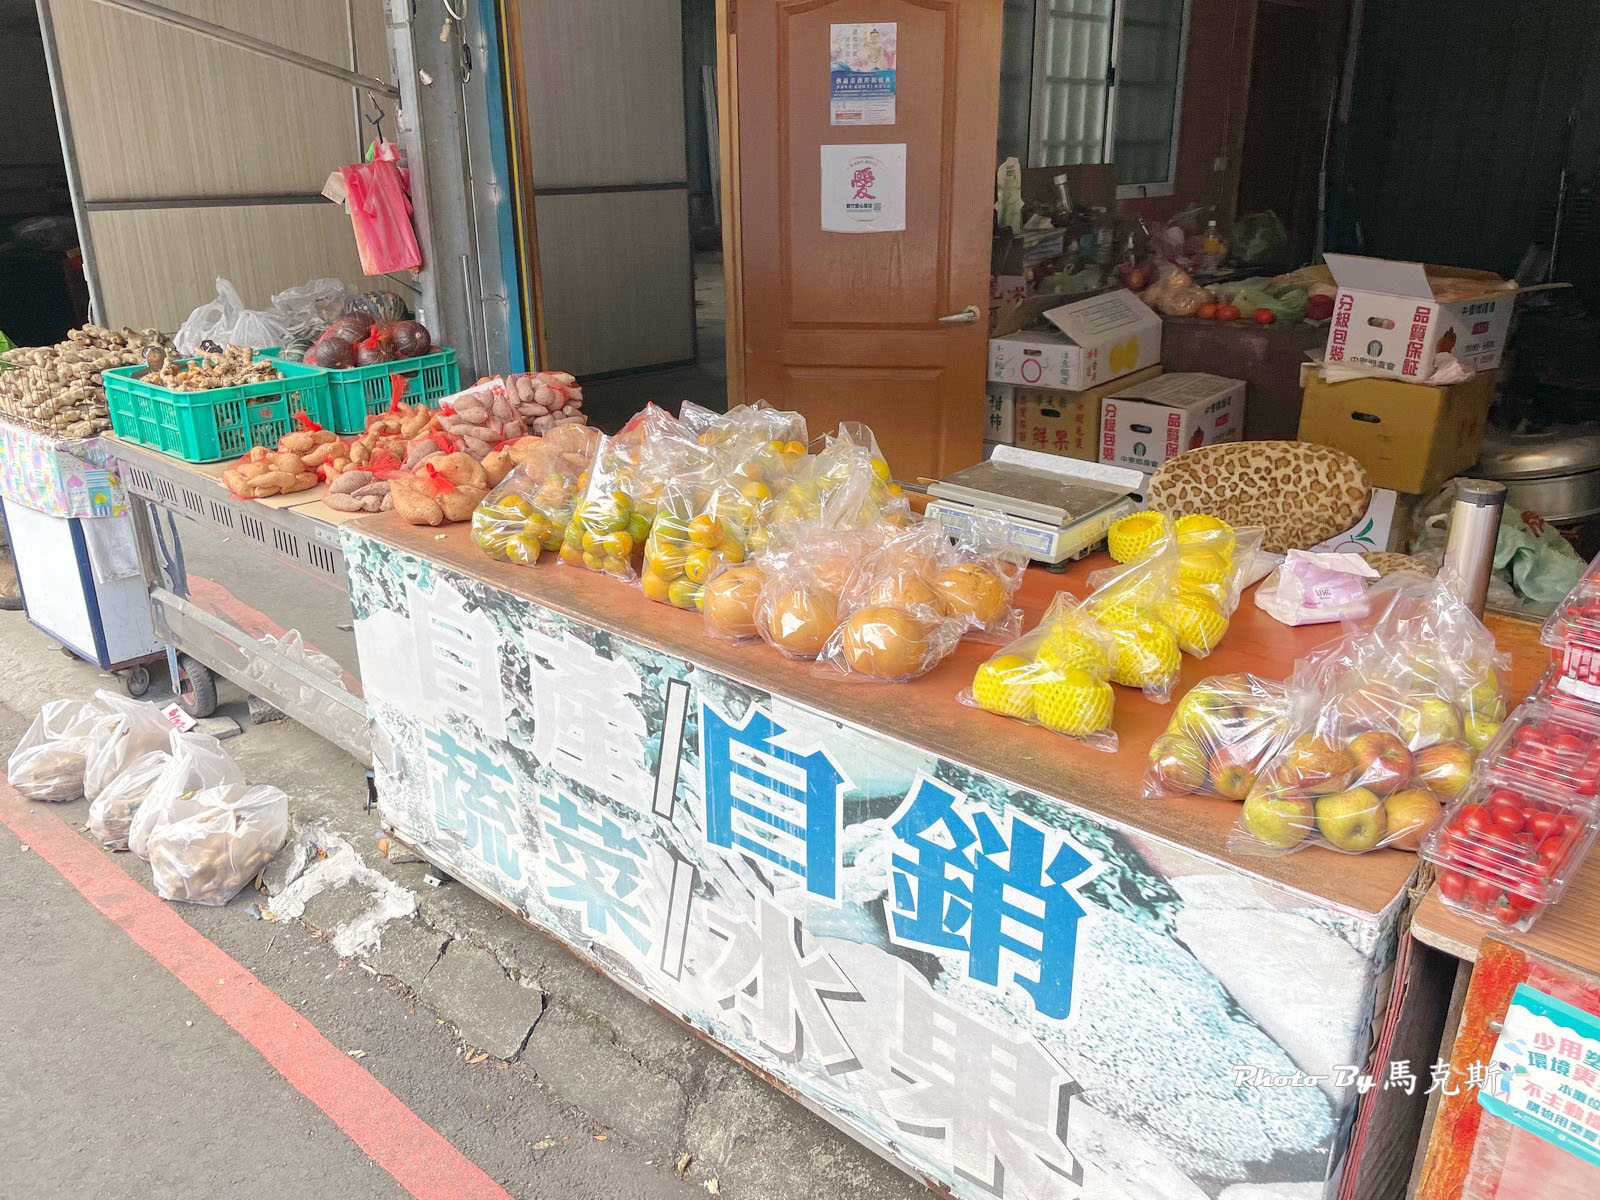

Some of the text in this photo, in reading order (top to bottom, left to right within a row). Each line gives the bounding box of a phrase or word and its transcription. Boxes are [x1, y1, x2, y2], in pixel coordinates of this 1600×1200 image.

[1329, 294, 1354, 361] 分級包裝
[1401, 306, 1431, 377] 品質保証
[1032, 427, 1070, 451] 鮮果
[1103, 403, 1117, 462] 分級包裝
[1165, 412, 1181, 461] 品質保
[406, 580, 1092, 1021] 自產 自銷
[425, 728, 1080, 1190] 蔬菜 水果
[1528, 1051, 1600, 1094] 環境更
[1526, 1100, 1600, 1145] 購物用塑膠
